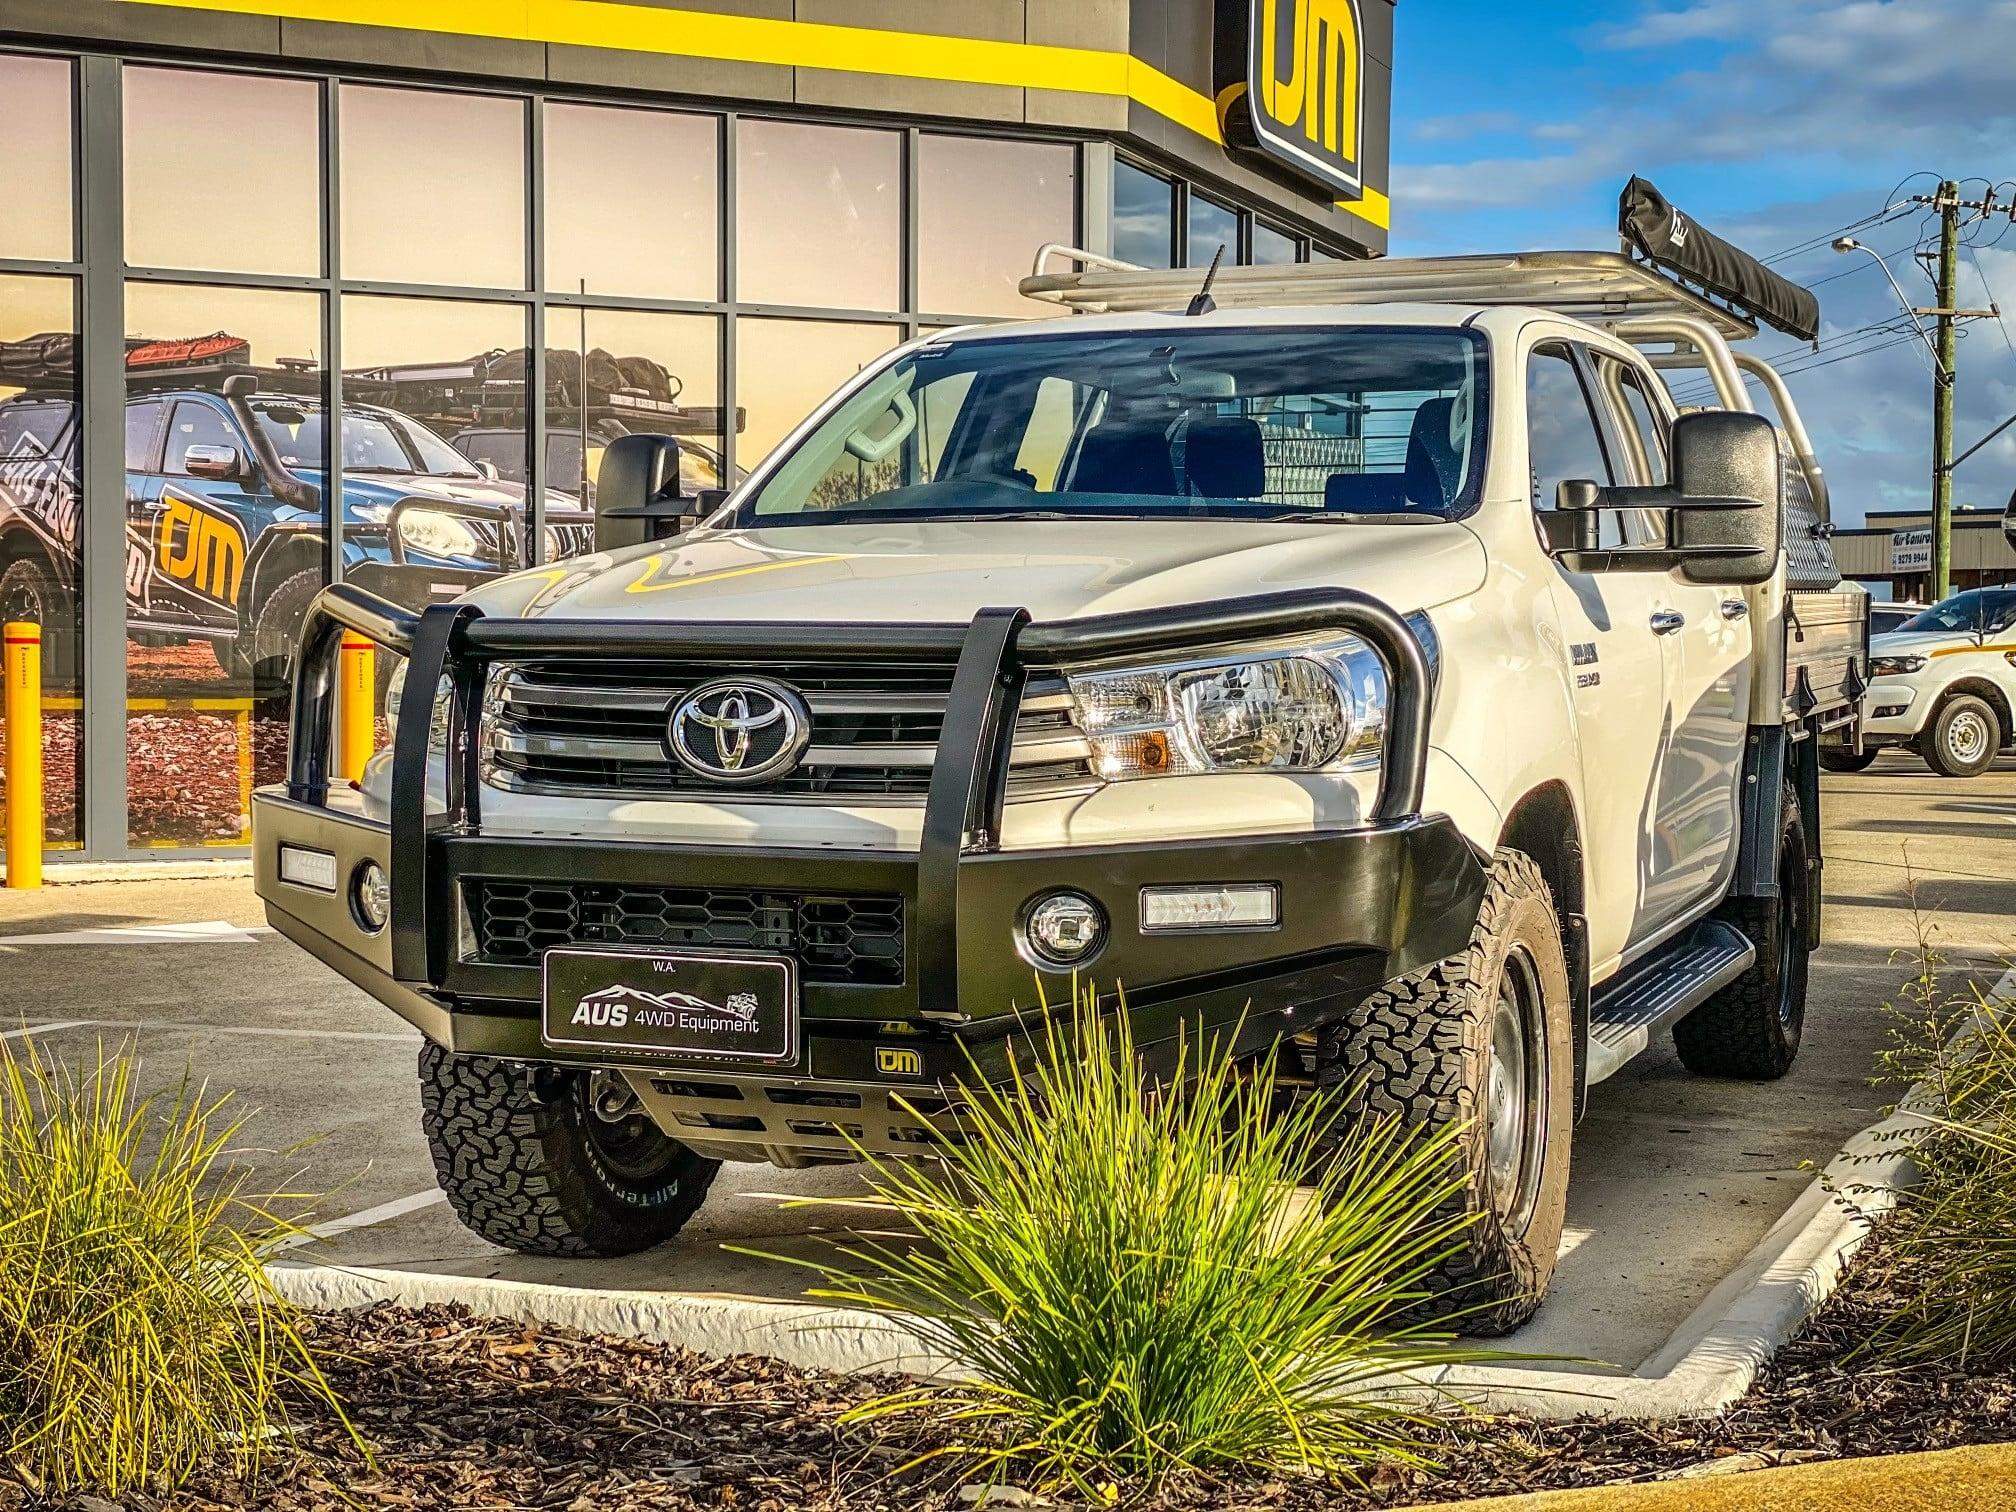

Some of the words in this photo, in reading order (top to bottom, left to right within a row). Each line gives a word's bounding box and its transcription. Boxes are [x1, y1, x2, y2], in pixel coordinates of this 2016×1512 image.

[161, 495, 244, 606] TJM
[652, 960, 677, 973] W.A.
[571, 1001, 629, 1028] AUS
[634, 1010, 675, 1027] 4WD
[679, 1012, 760, 1033] Equipment
[879, 1050, 919, 1073] TJM
